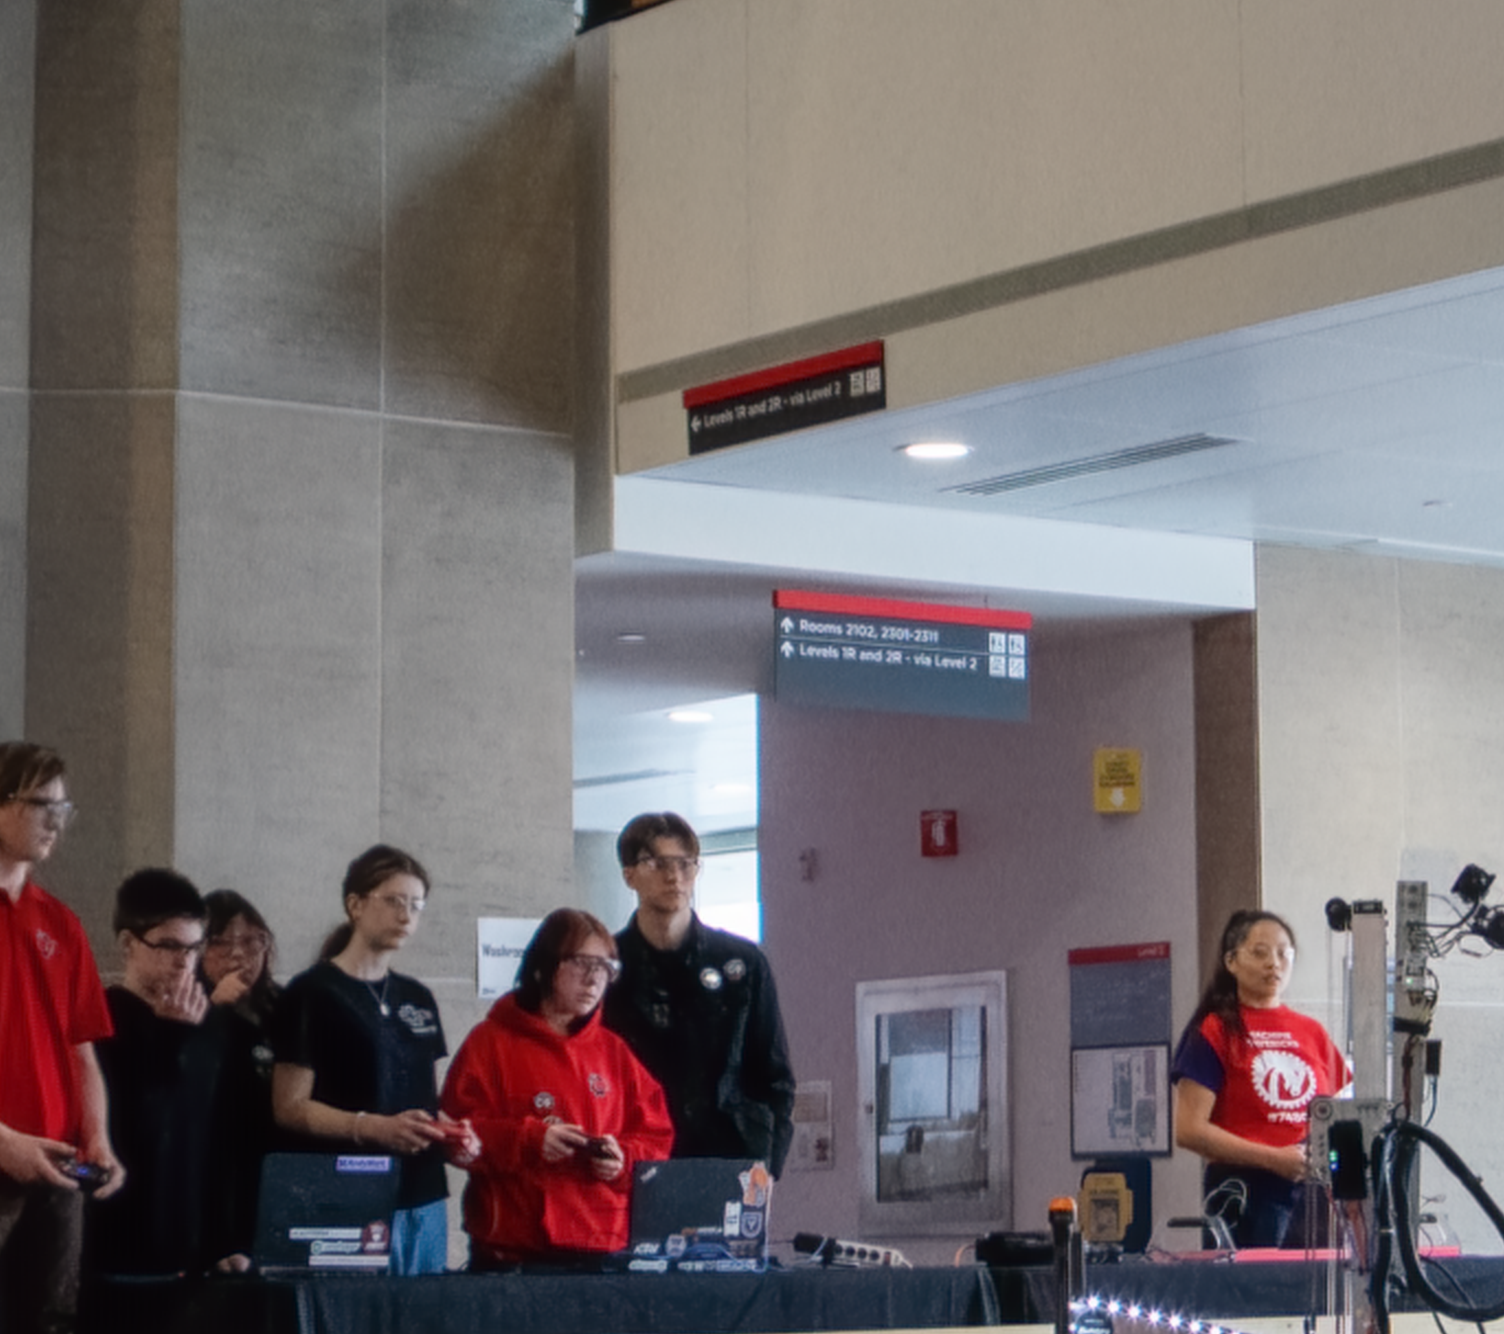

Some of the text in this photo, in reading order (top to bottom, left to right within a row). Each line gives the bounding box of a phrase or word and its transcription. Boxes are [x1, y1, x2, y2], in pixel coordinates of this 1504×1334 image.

[703, 409, 734, 427] Levels
[747, 400, 767, 418] and
[790, 392, 804, 406] via
[806, 382, 832, 402] Level
[800, 619, 842, 635] Rooms
[799, 643, 839, 658] Levels
[842, 647, 856, 661] 1R
[859, 648, 883, 662] and
[886, 651, 902, 664] 2R
[913, 653, 932, 667] via
[934, 655, 966, 668] Level
[969, 657, 977, 670] 2
